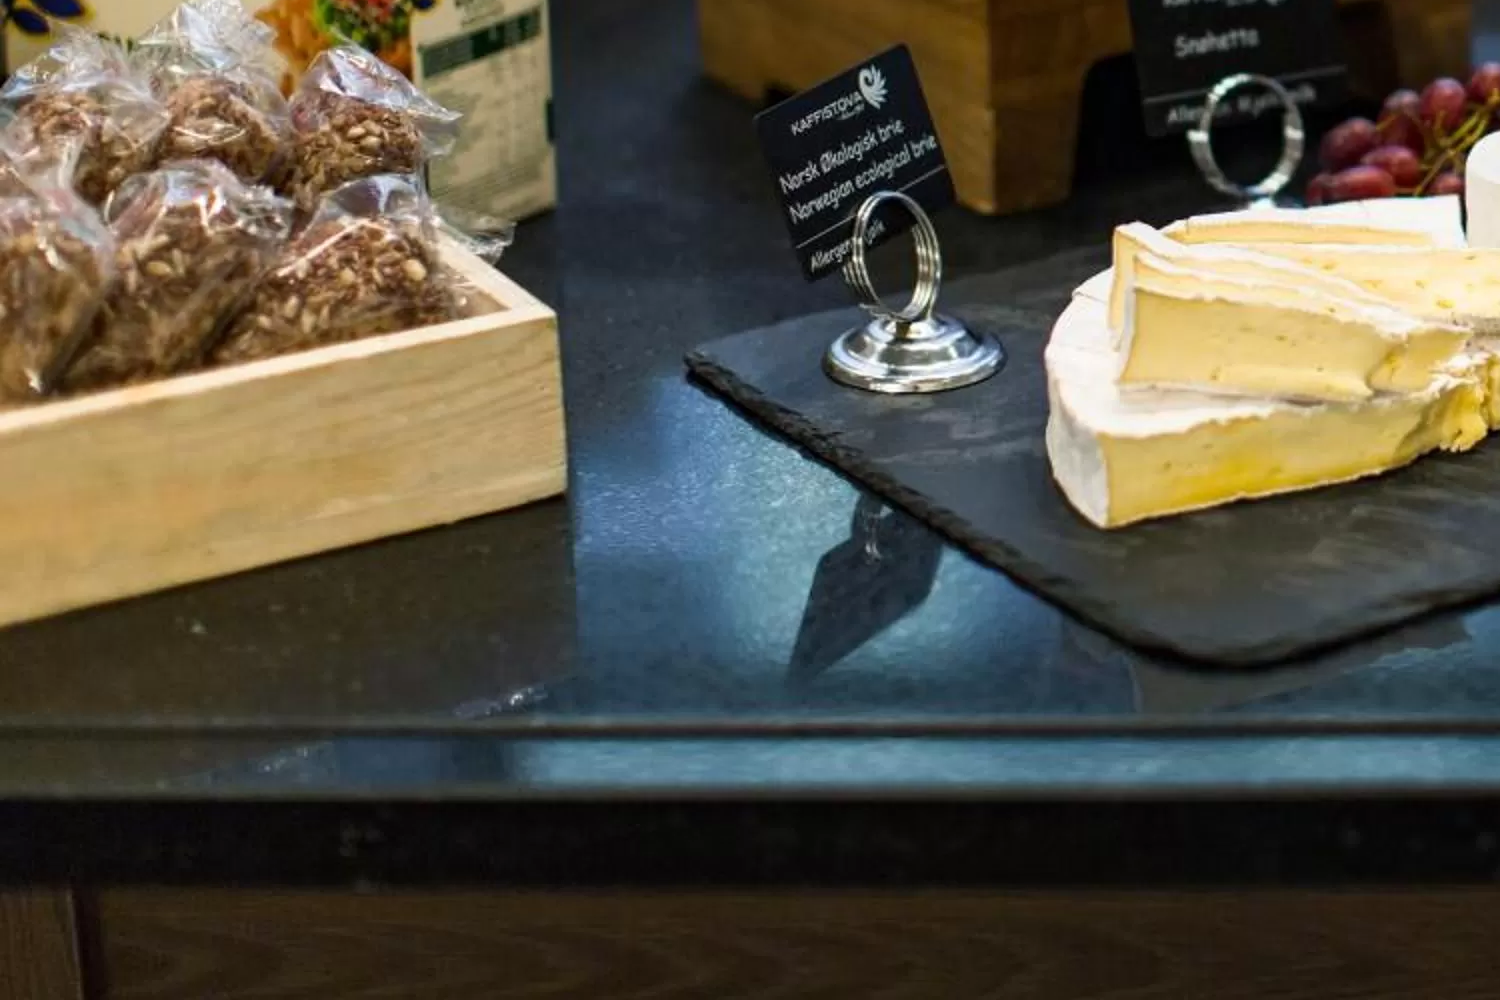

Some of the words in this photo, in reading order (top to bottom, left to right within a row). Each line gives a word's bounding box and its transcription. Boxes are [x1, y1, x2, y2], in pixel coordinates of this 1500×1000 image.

[789, 91, 864, 136] KAFFISTOVA
[778, 161, 821, 195] Norsk
[876, 118, 906, 144] brie
[789, 179, 854, 225] Norwegian
[855, 148, 910, 190] ecological
[910, 134, 938, 162] brie
